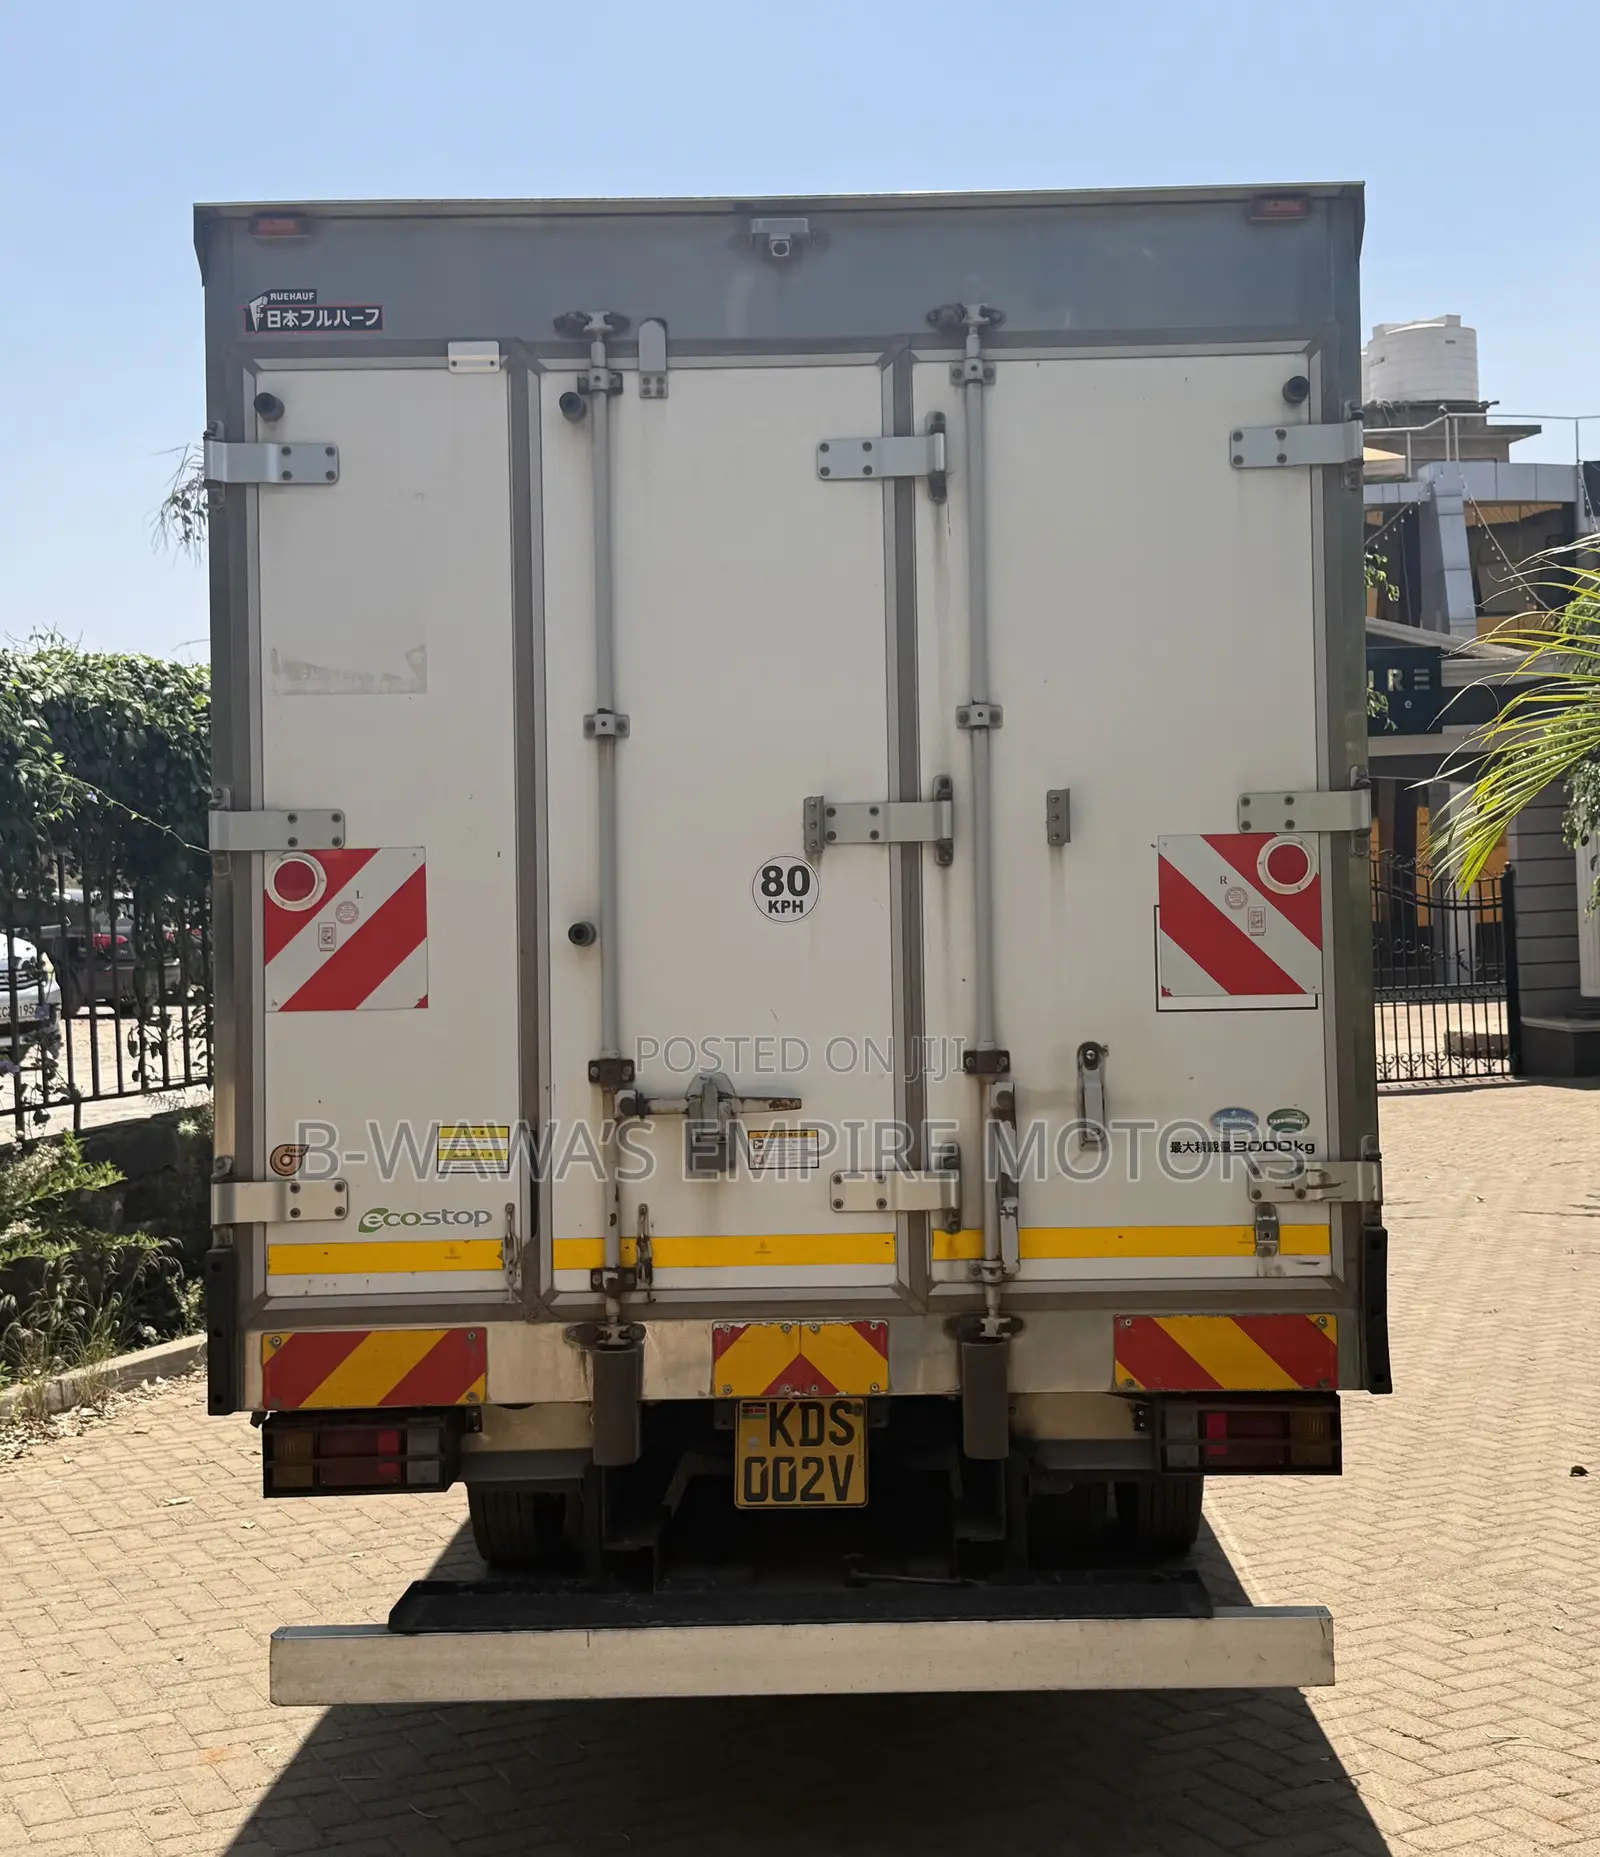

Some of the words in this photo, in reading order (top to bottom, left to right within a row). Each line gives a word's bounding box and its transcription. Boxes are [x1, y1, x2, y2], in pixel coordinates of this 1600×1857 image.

[267, 309, 380, 328] 日本フルハーフ
[761, 865, 810, 897] 80
[1219, 875, 1228, 885] R
[768, 899, 804, 914] KPH
[359, 1208, 493, 1231] ecostop
[769, 1400, 855, 1447] KDS
[743, 1455, 855, 1502] 002V
